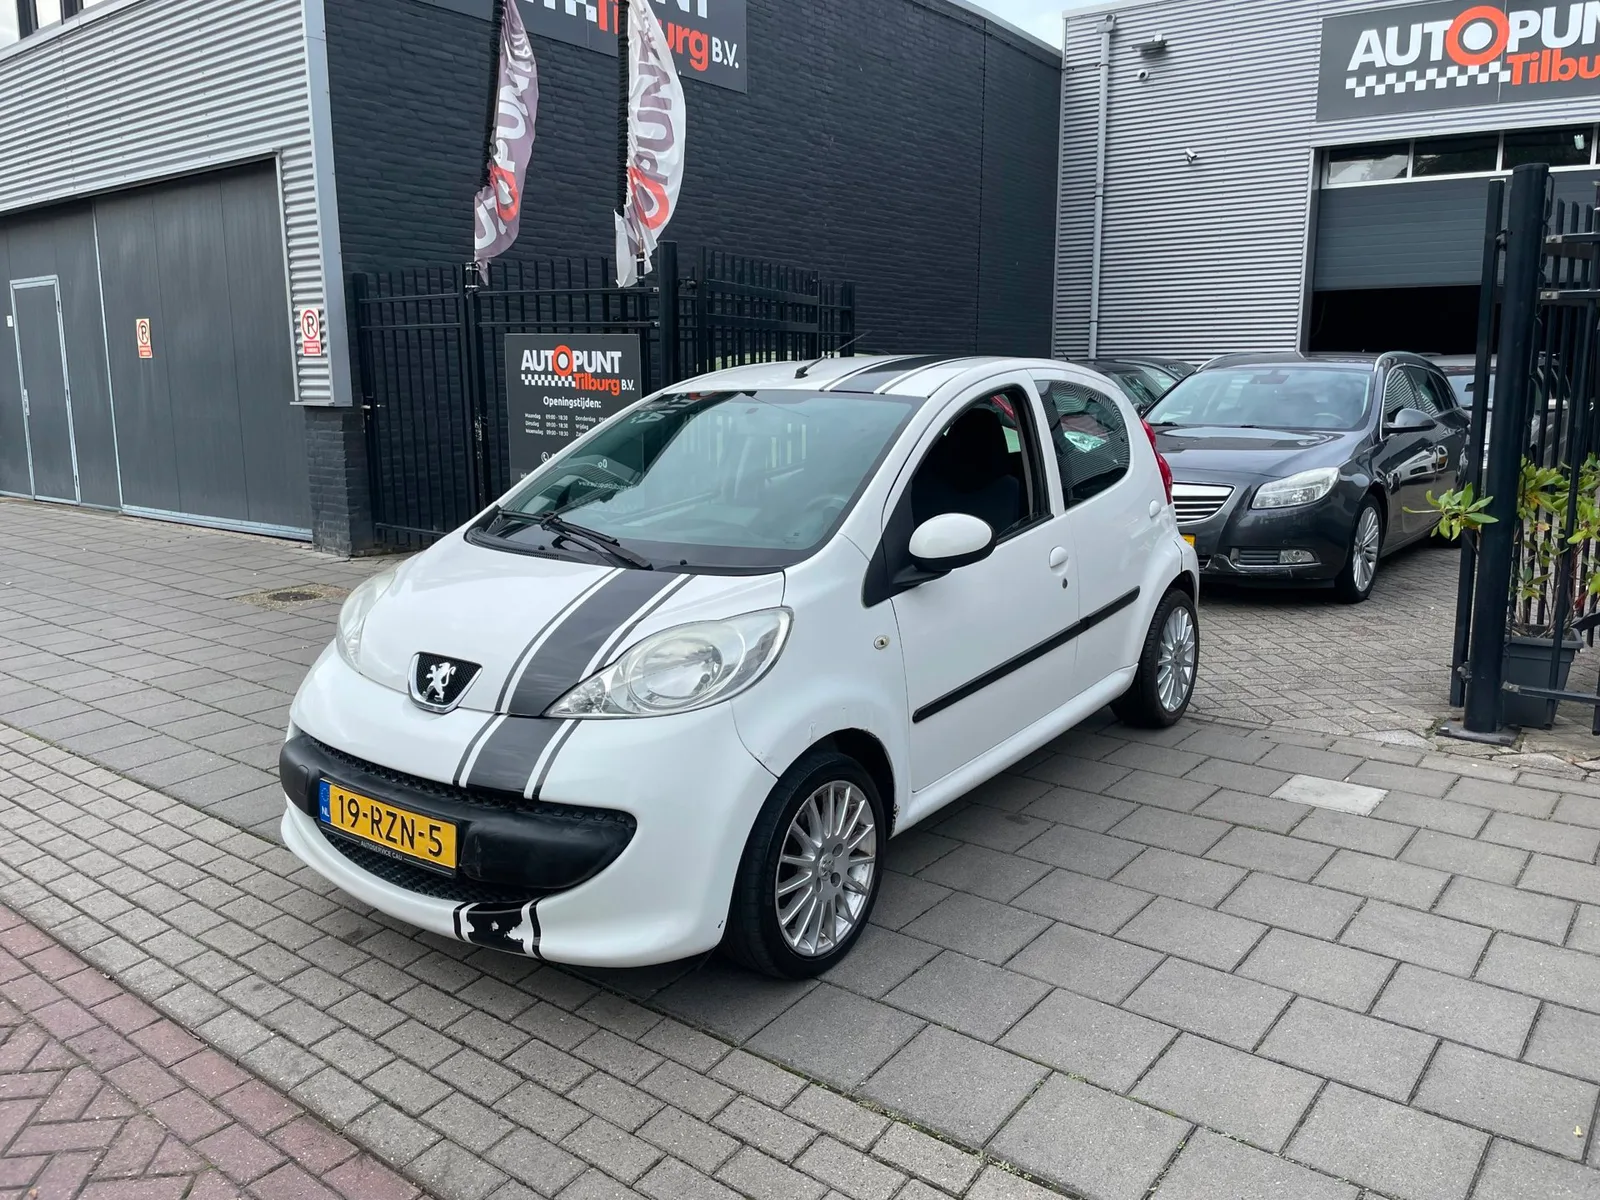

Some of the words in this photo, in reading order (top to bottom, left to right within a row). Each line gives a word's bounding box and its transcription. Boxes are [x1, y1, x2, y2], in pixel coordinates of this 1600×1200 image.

[711, 36, 739, 69] B.V.
[1506, 49, 1600, 86] Tilbu
[520, 345, 622, 377] AUTOPUNT
[573, 373, 620, 396] Tilburg
[621, 379, 635, 391] B.V.
[542, 396, 602, 410] Openingstijden:
[321, 806, 330, 817] NL
[338, 794, 443, 857] 19-RZN-5
